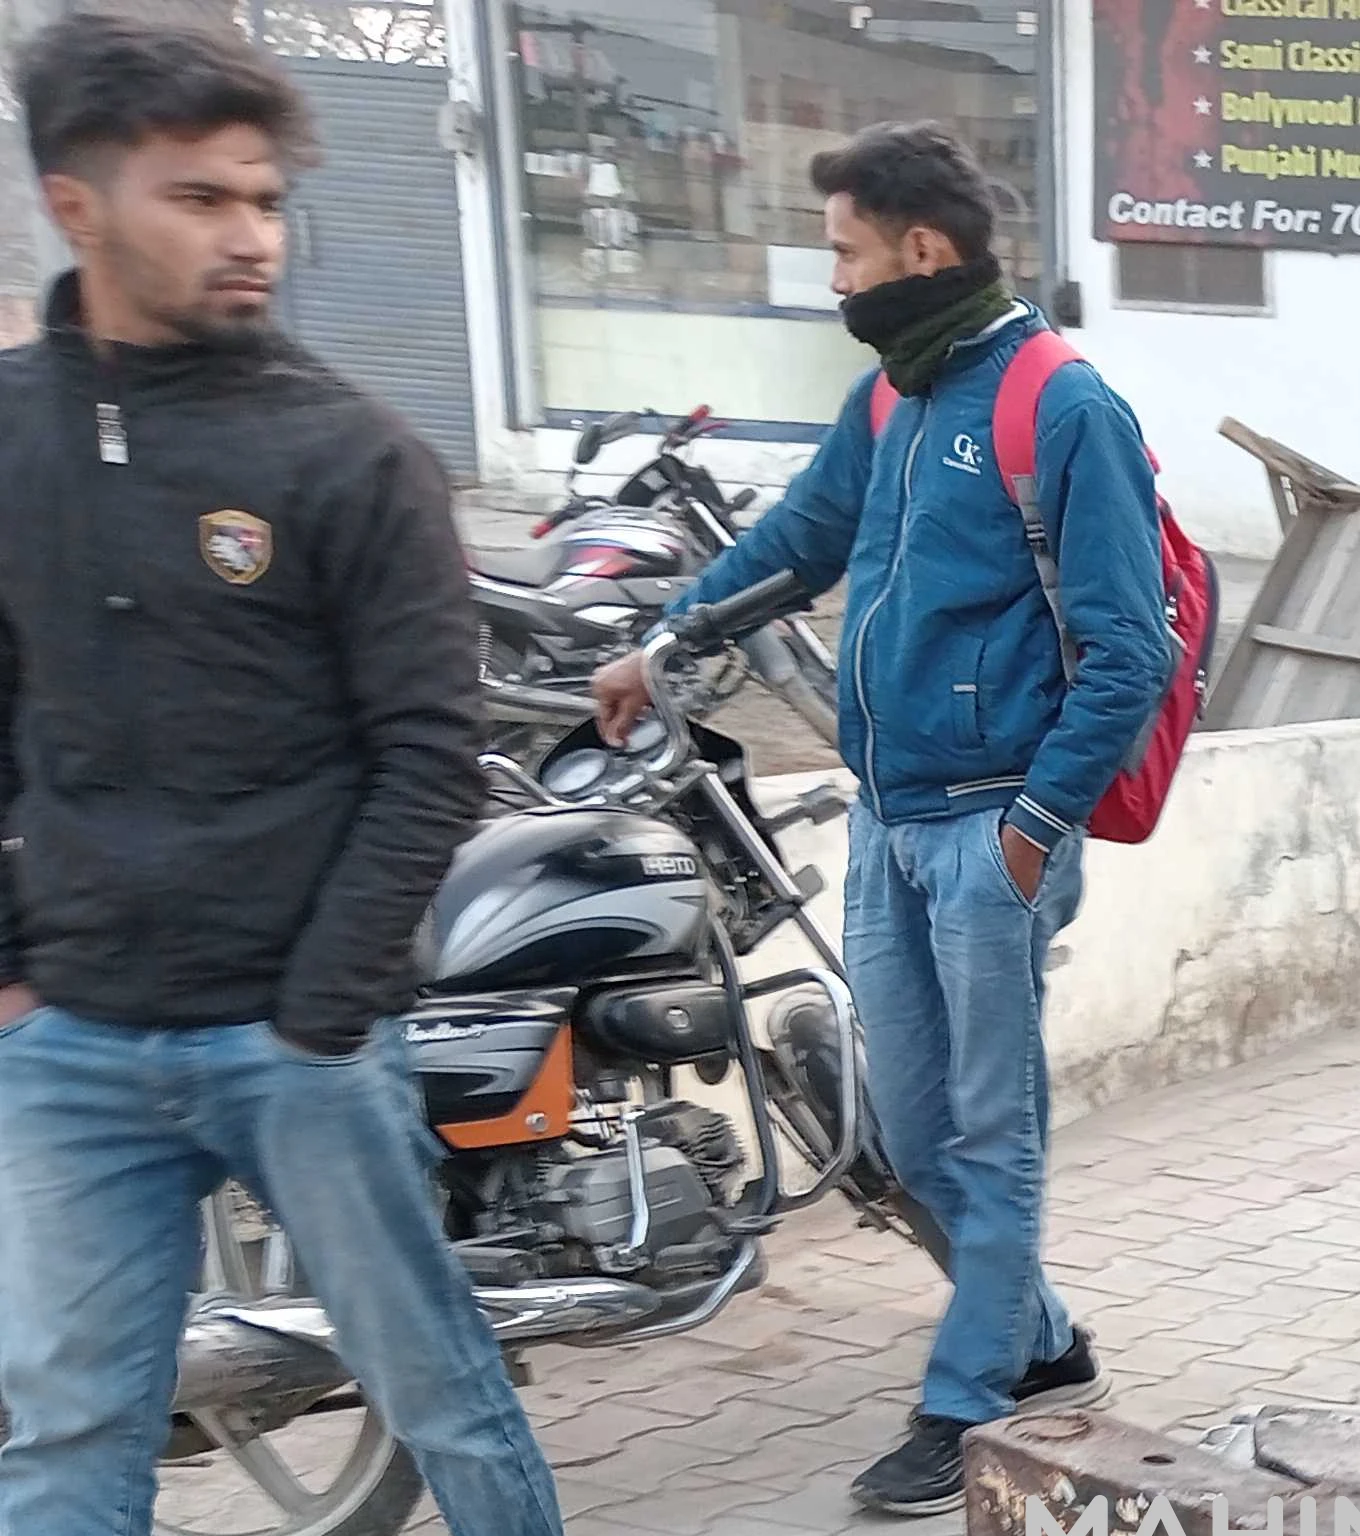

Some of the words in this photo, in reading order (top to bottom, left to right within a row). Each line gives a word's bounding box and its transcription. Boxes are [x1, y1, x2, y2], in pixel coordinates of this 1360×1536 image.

[1219, 39, 1284, 71] Semi
[1220, 90, 1354, 128] Bollywood
[1221, 143, 1317, 180] Punjabi
[1107, 192, 1244, 230] Contact
[1252, 199, 1322, 234] For:
